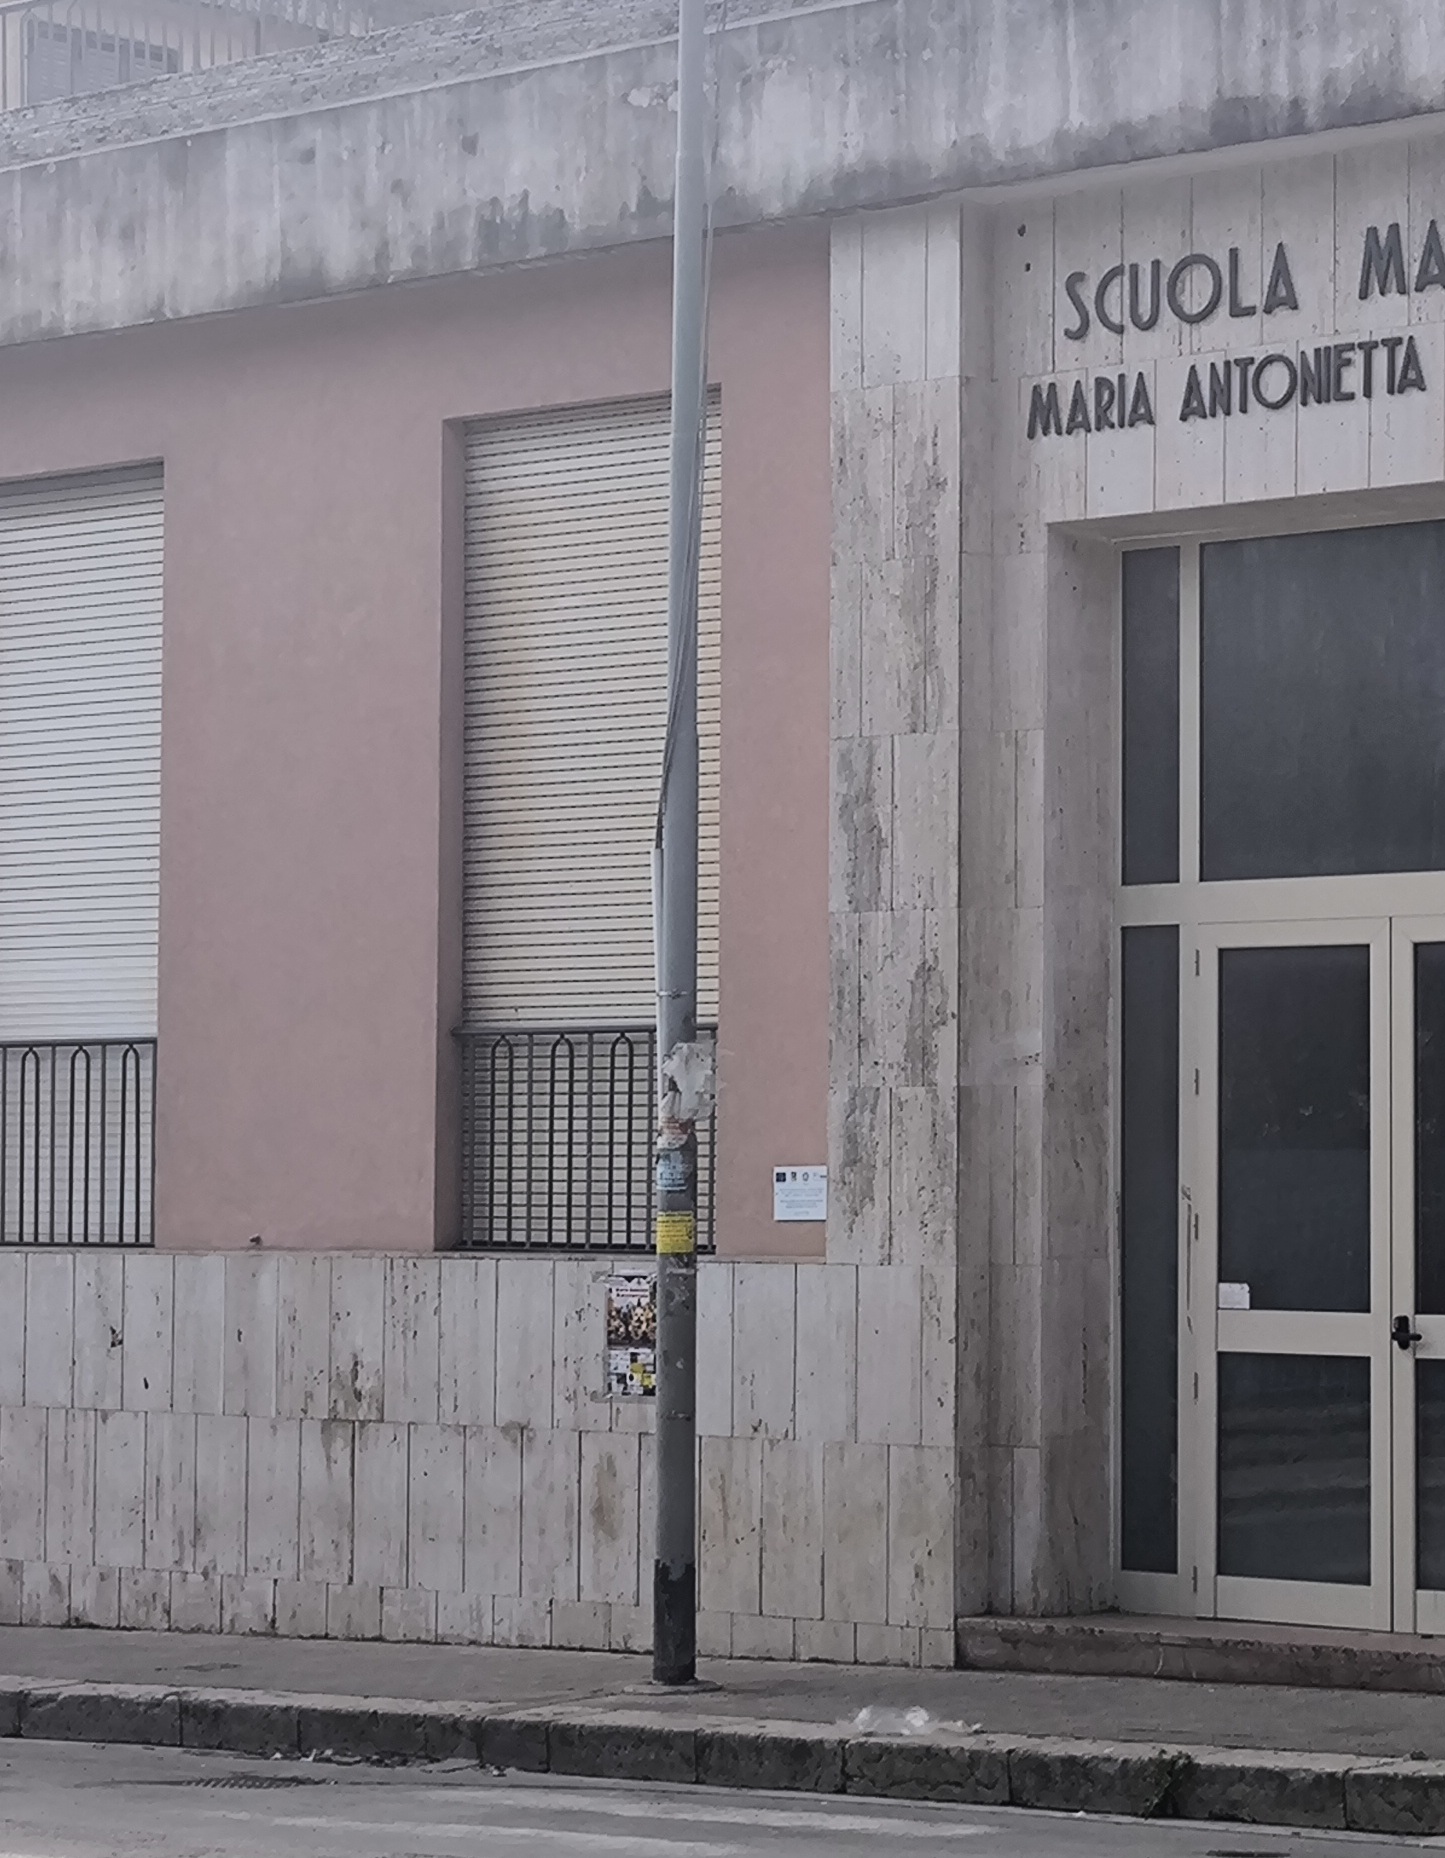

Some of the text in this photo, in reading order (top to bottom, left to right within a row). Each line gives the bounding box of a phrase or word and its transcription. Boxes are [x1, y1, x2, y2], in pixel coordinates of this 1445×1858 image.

[1063, 241, 1300, 341] SCUOLA
[1026, 370, 1156, 440] MARIA
[1178, 333, 1427, 423] ANTONIETTA
